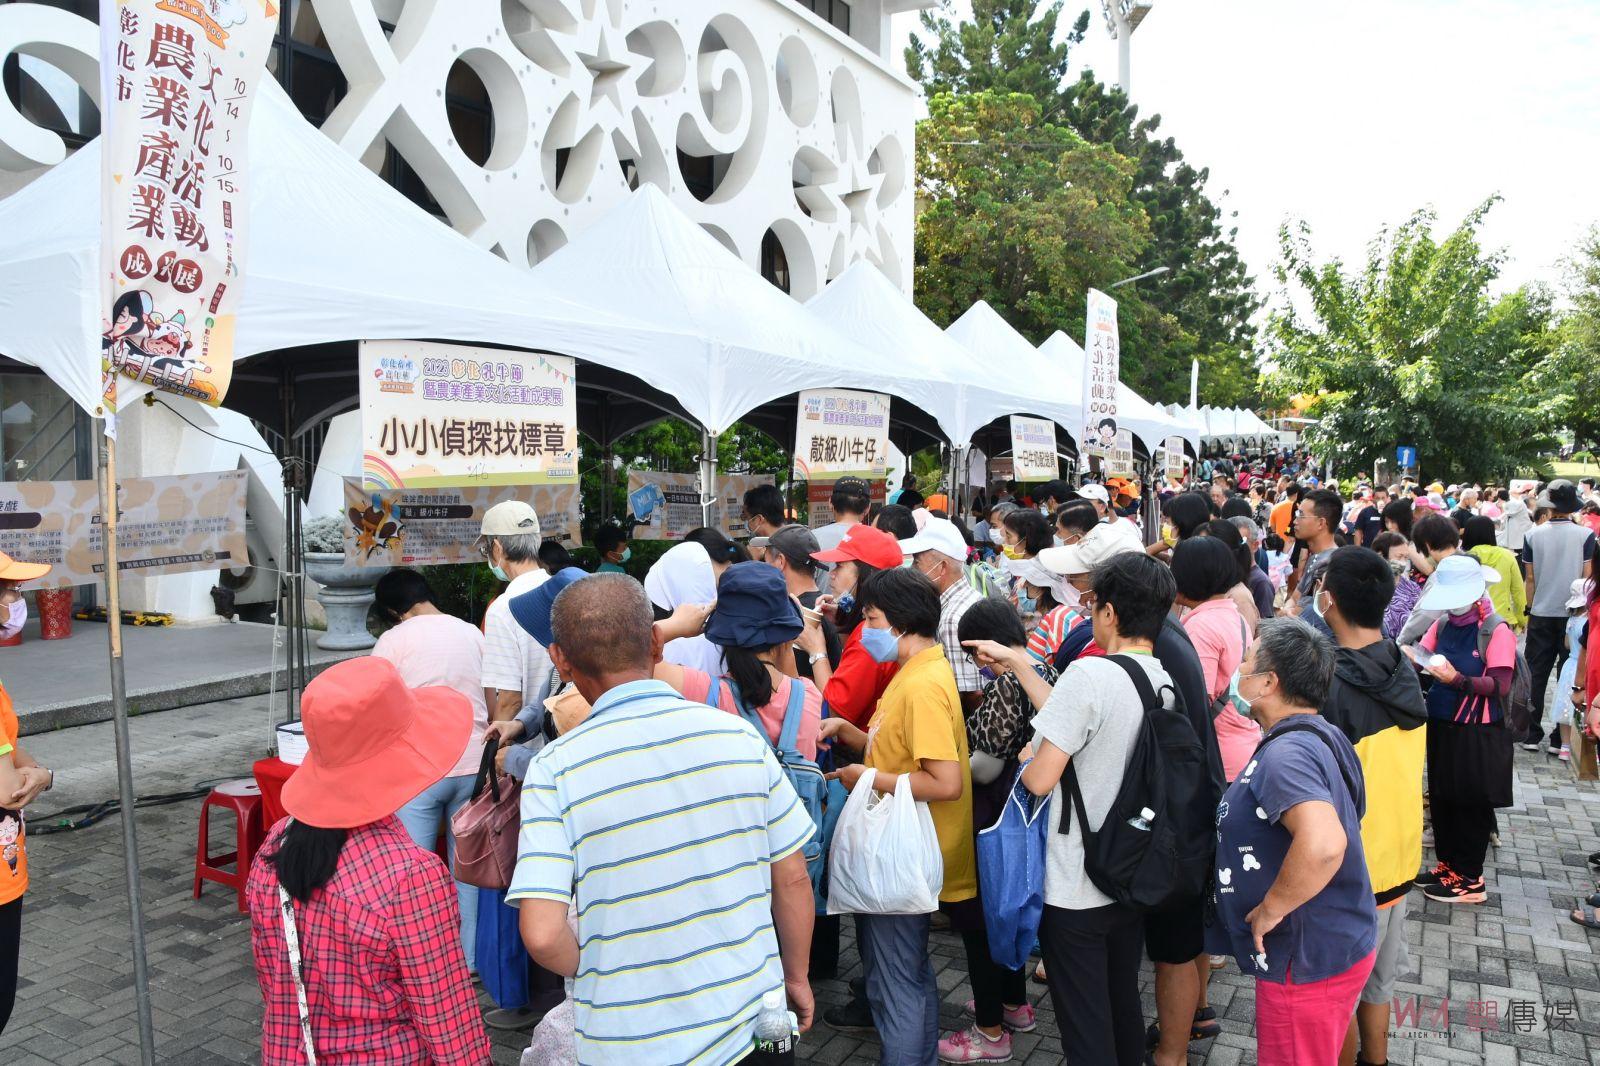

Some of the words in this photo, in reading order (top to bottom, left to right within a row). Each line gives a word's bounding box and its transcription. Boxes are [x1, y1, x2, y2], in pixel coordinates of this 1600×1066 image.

[116, 5, 139, 101] 彰化市
[127, 22, 196, 241] 農業產業
[169, 50, 222, 252] 文化活動
[380, 417, 565, 457] 小小偵探找標章
[809, 434, 877, 464] 敲級小牛仔
